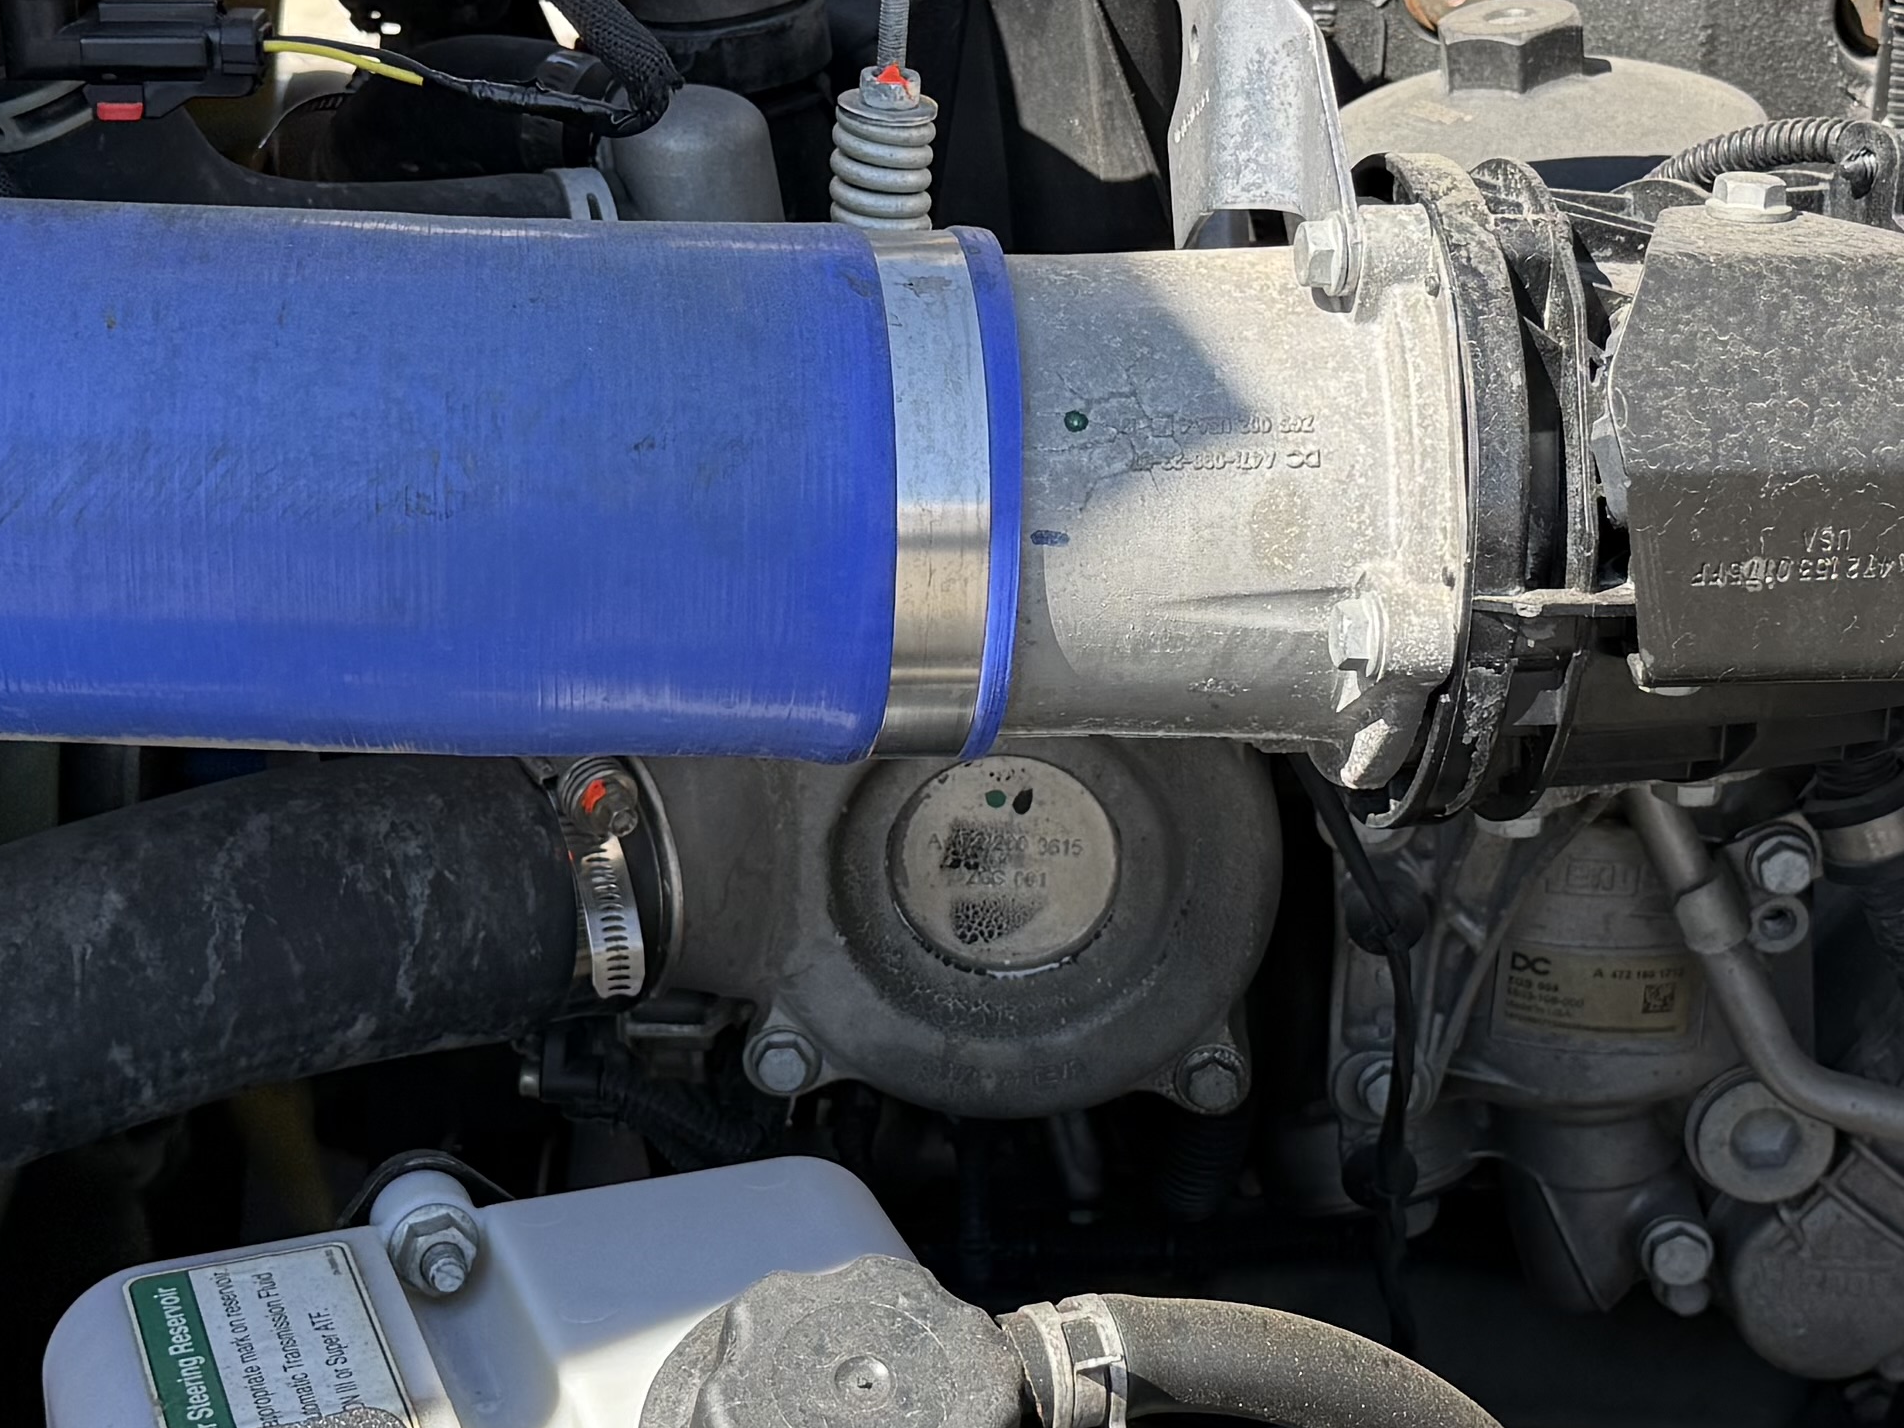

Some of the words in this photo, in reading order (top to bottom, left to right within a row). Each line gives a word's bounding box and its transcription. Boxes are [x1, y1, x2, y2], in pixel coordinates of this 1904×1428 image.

[1510, 951, 1552, 976] DC
[214, 1268, 241, 1317] reservoir.
[251, 1272, 278, 1299] Fluid
[153, 1286, 193, 1357] Reservoir
[229, 1318, 247, 1333] on
[308, 1308, 334, 1331] ATF.
[231, 1335, 257, 1363] mark
[265, 1298, 303, 1372] Transmission
[322, 1334, 347, 1366] Super
[176, 1353, 211, 1421] Steering
[335, 1367, 352, 1379] or
[335, 1380, 357, 1393] III
[290, 1372, 324, 1424] utomatic
